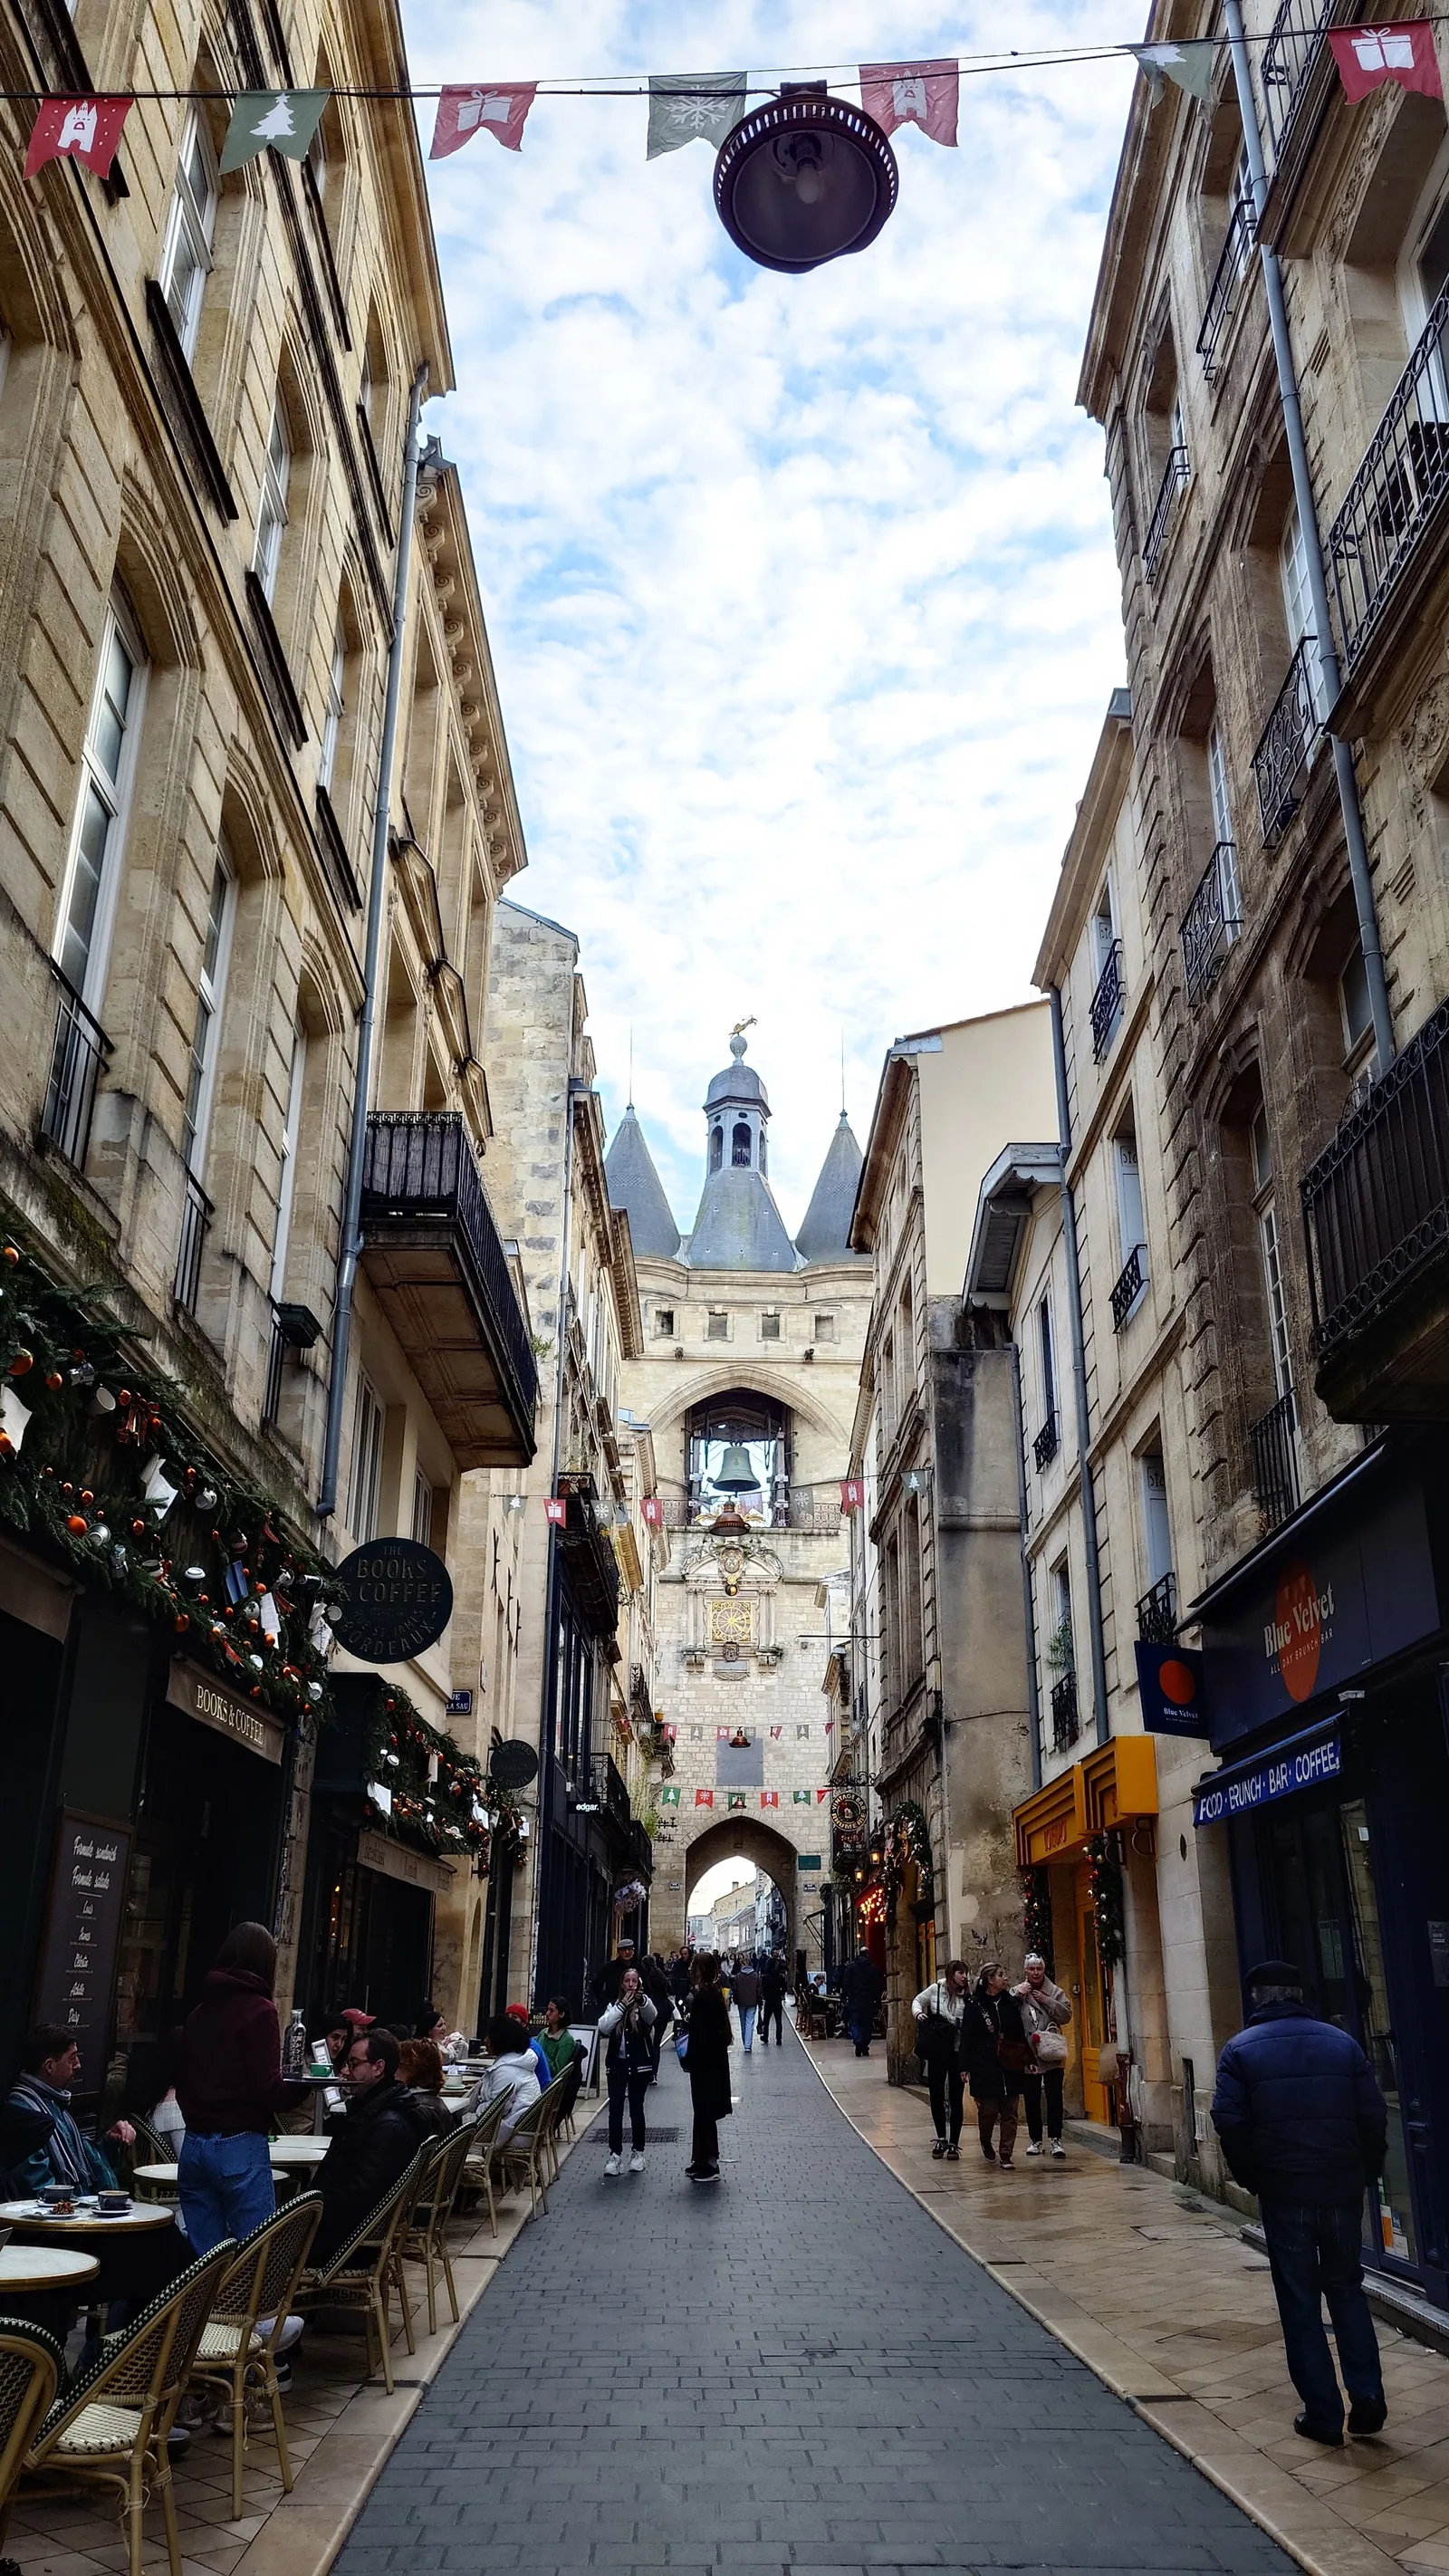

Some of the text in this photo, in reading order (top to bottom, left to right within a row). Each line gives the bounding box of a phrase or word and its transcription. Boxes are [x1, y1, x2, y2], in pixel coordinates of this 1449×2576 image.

[382, 1545, 403, 1556] THE
[356, 1558, 427, 1579] BOOKS
[359, 1582, 442, 1602] COFFEE
[1263, 1581, 1335, 1658] Blue Velvet
[340, 1620, 436, 1656] BORDEAUX
[1270, 1628, 1334, 1676] ALL DAY BRUNCH BAR
[196, 1685, 264, 1745] BOOKS & COFFEE
[1163, 1707, 1199, 1719] Blue Velvet
[1199, 1741, 1337, 1821] FOOD BRUNCH BAR COFFEE
[831, 1793, 867, 1811] VINTAGE BAR
